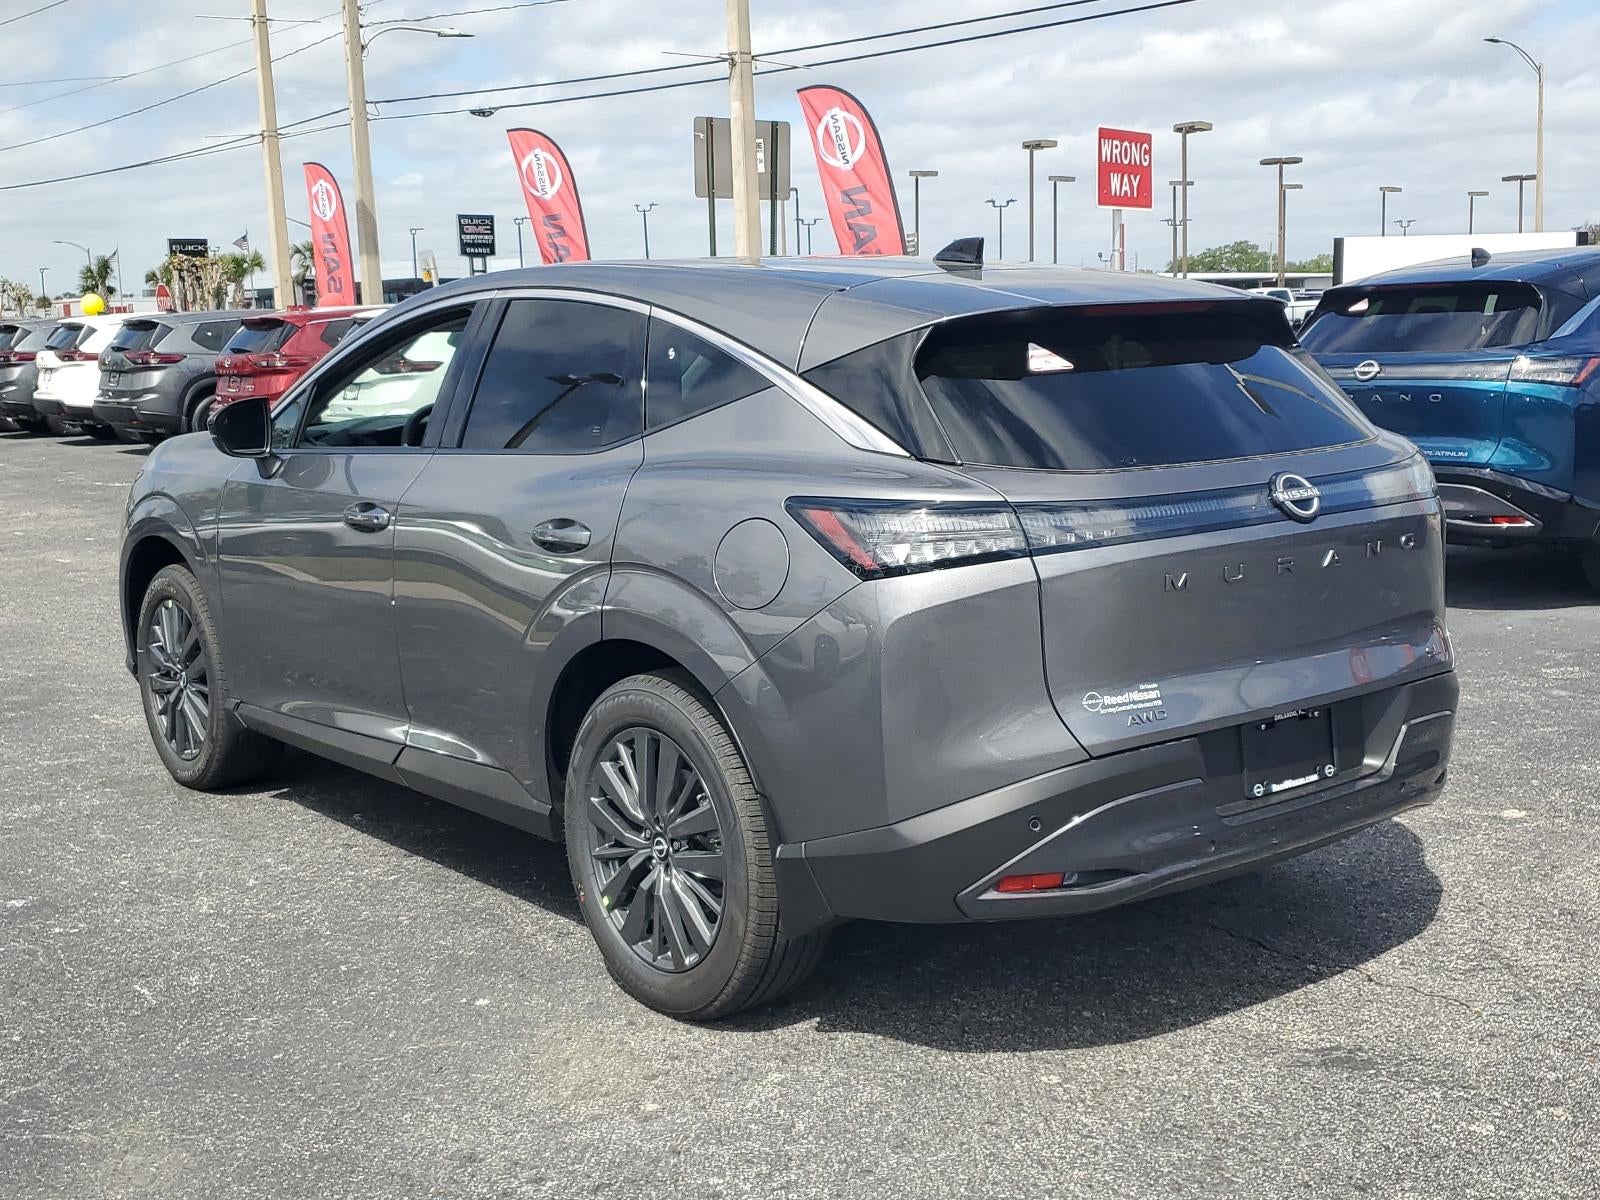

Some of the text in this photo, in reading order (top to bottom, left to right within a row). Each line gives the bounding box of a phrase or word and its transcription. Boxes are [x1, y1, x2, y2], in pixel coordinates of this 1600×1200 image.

[1101, 138, 1150, 167] WRONG
[1110, 171, 1140, 198] WAY
[463, 225, 491, 234] GMC
[1277, 487, 1320, 501] NISSAN
[1163, 532, 1416, 592] MURANO
[1103, 689, 1161, 705] Reed Nissan
[1127, 710, 1168, 727] AWD
